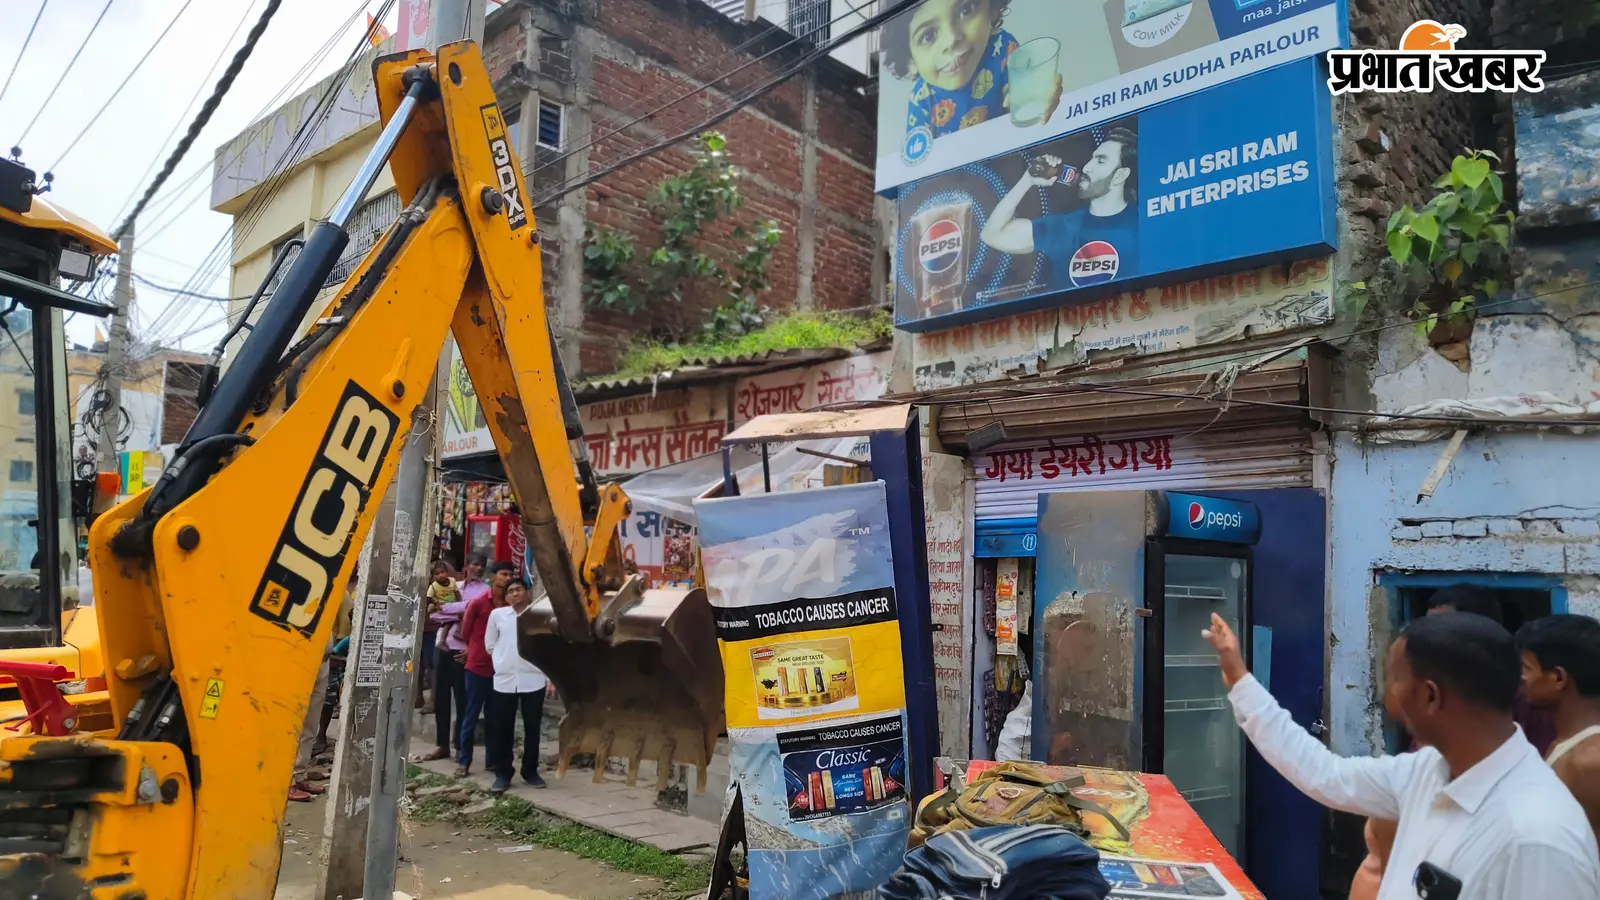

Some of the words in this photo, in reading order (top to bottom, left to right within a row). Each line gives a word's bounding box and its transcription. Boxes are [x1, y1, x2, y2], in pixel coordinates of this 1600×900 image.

[1132, 28, 1158, 41] COW
[1159, 11, 1186, 35] MILK
[1242, 6, 1273, 24] maa
[1065, 100, 1089, 120] JAI
[1092, 91, 1117, 112] SRI
[1120, 77, 1159, 102] RAM
[1162, 56, 1226, 88] SUDHA
[1229, 25, 1321, 67] PARLOUR
[1159, 156, 1197, 185] JAI
[1199, 147, 1240, 176] SRI
[1242, 130, 1298, 164] RAM
[491, 139, 524, 218] 3DX
[1146, 160, 1310, 218] ENTERPRISES
[508, 211, 526, 226] SUPER
[920, 237, 961, 257] PEPSI
[1072, 259, 1116, 272] PEPSI
[442, 435, 478, 453] ARLOUR
[582, 424, 612, 470] जा
[985, 447, 1035, 482] गया
[1036, 433, 1107, 480] डेयरी
[1108, 434, 1174, 472] गया
[276, 395, 391, 628] JCB
[1206, 510, 1242, 530] pepsi
[1024, 536, 1035, 549] 11
[755, 606, 805, 630] TOBACCO
[806, 602, 847, 622] CAUSES
[847, 596, 890, 618] CANCER
[818, 729, 849, 742] TOBACCO
[849, 725, 875, 737] CAUSES
[875, 721, 901, 734] CANCER
[815, 747, 872, 770] Classic
